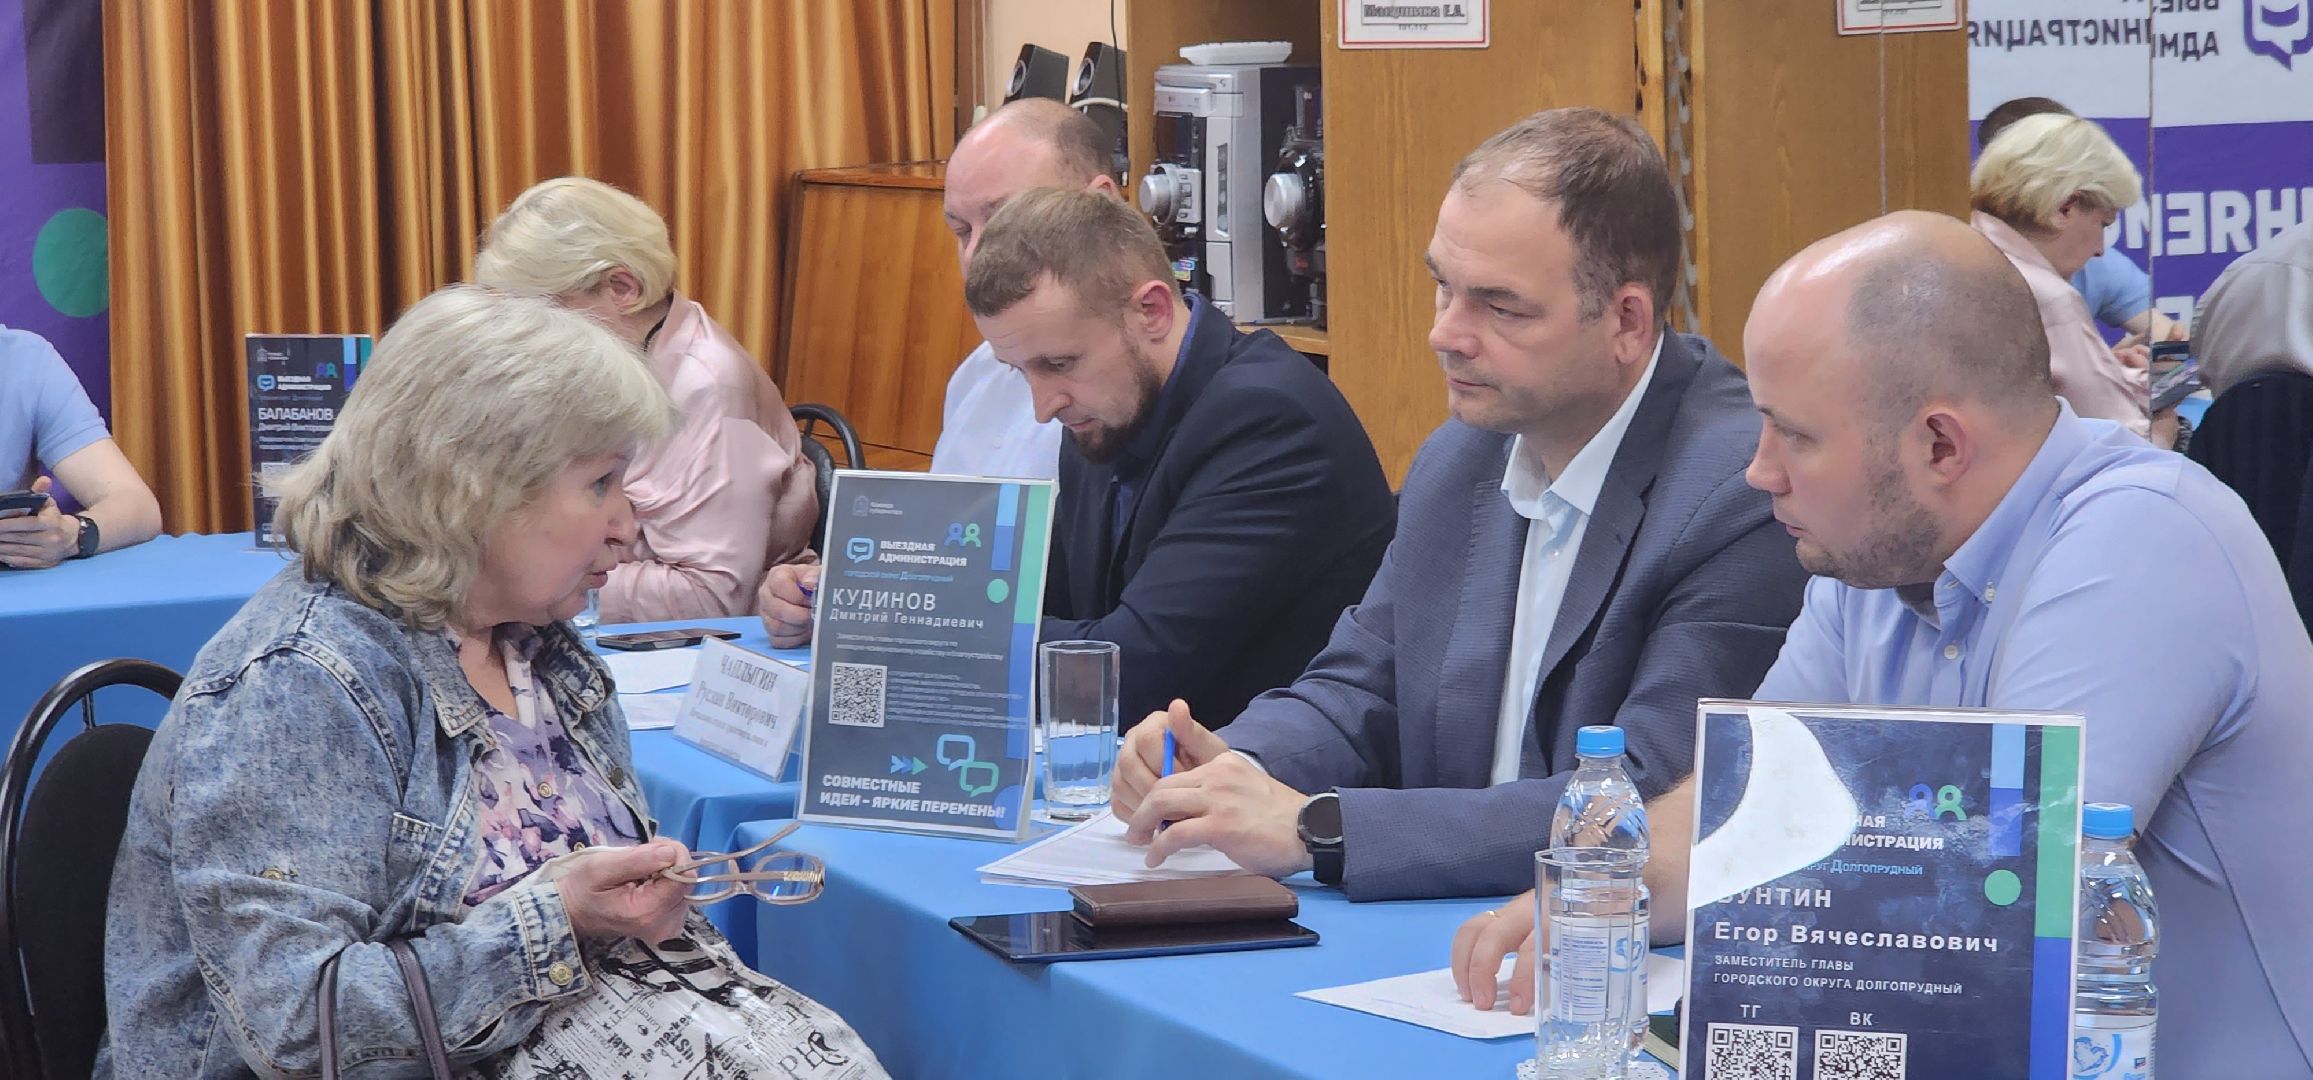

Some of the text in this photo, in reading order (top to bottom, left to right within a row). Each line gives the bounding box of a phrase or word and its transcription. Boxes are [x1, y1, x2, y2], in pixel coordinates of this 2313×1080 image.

[258, 407, 334, 421] БАЛАБАНОВ
[880, 540, 936, 552] ВЫЕЗДНАЯ
[878, 553, 968, 567] АДМИНИСТРАЦИЯ
[832, 588, 936, 611] КУДИНОВ
[829, 608, 984, 629] Дмитрий Геннадиевич
[721, 654, 778, 693] ЧАПЛЫГИН
[822, 774, 922, 794] СОВМЕСТНЫЕ
[820, 791, 861, 807] ИДЕИ
[872, 796, 921, 812] ЯРКИЕ
[921, 800, 1006, 818] ПЕРЕМЕНЫ!
[1715, 921, 1998, 952] Егор Вячеславович
[1714, 955, 1854, 971] ЗАМЕСТИТЕЛЬ ГЛАВЫ
[1714, 973, 1963, 995] ГОРОДСКОГО ОКРУГА ДОЛГОПРУДНЫЙ
[1740, 1004, 1762, 1018] ТГ
[1850, 1012, 1873, 1026] ВК
